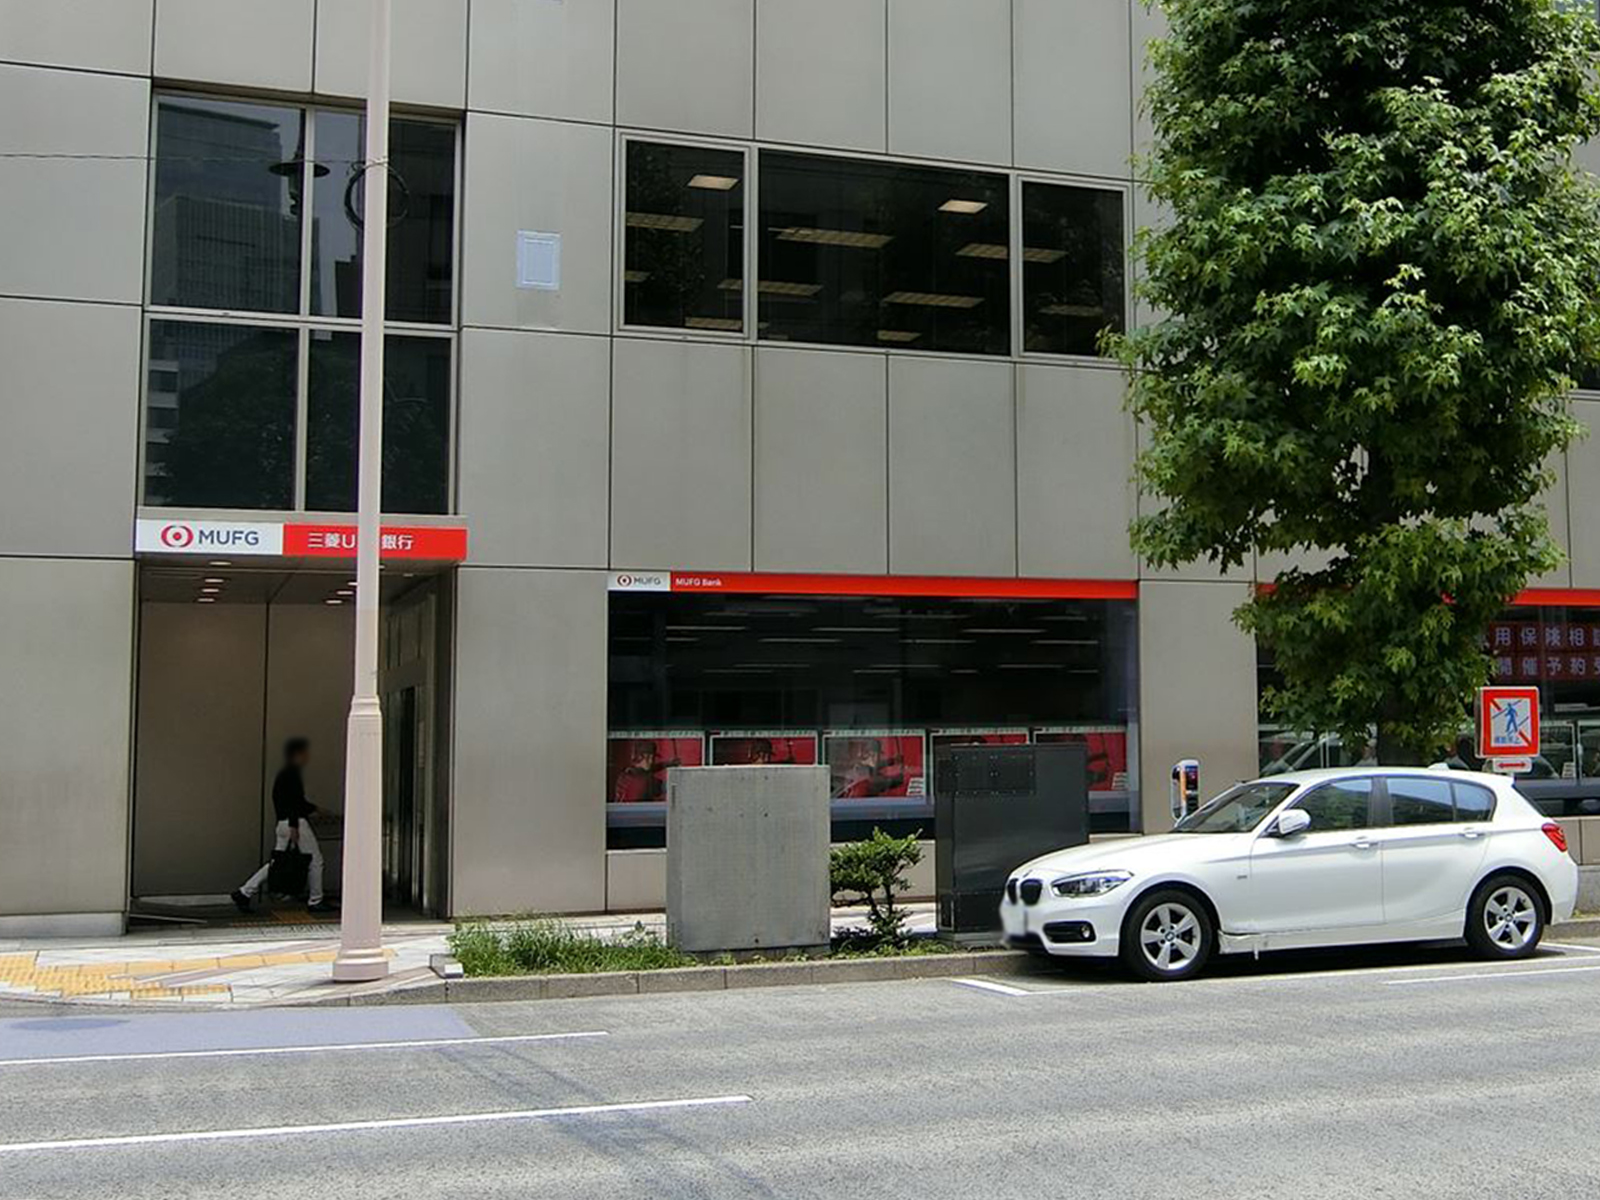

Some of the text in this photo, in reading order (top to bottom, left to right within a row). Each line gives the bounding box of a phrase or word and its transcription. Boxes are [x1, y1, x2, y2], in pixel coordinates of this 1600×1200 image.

[198, 529, 259, 546] MUFG
[307, 532, 413, 550] 三菱U銀行
[633, 576, 661, 585] MUFG
[675, 577, 722, 586] MUFG Bank
